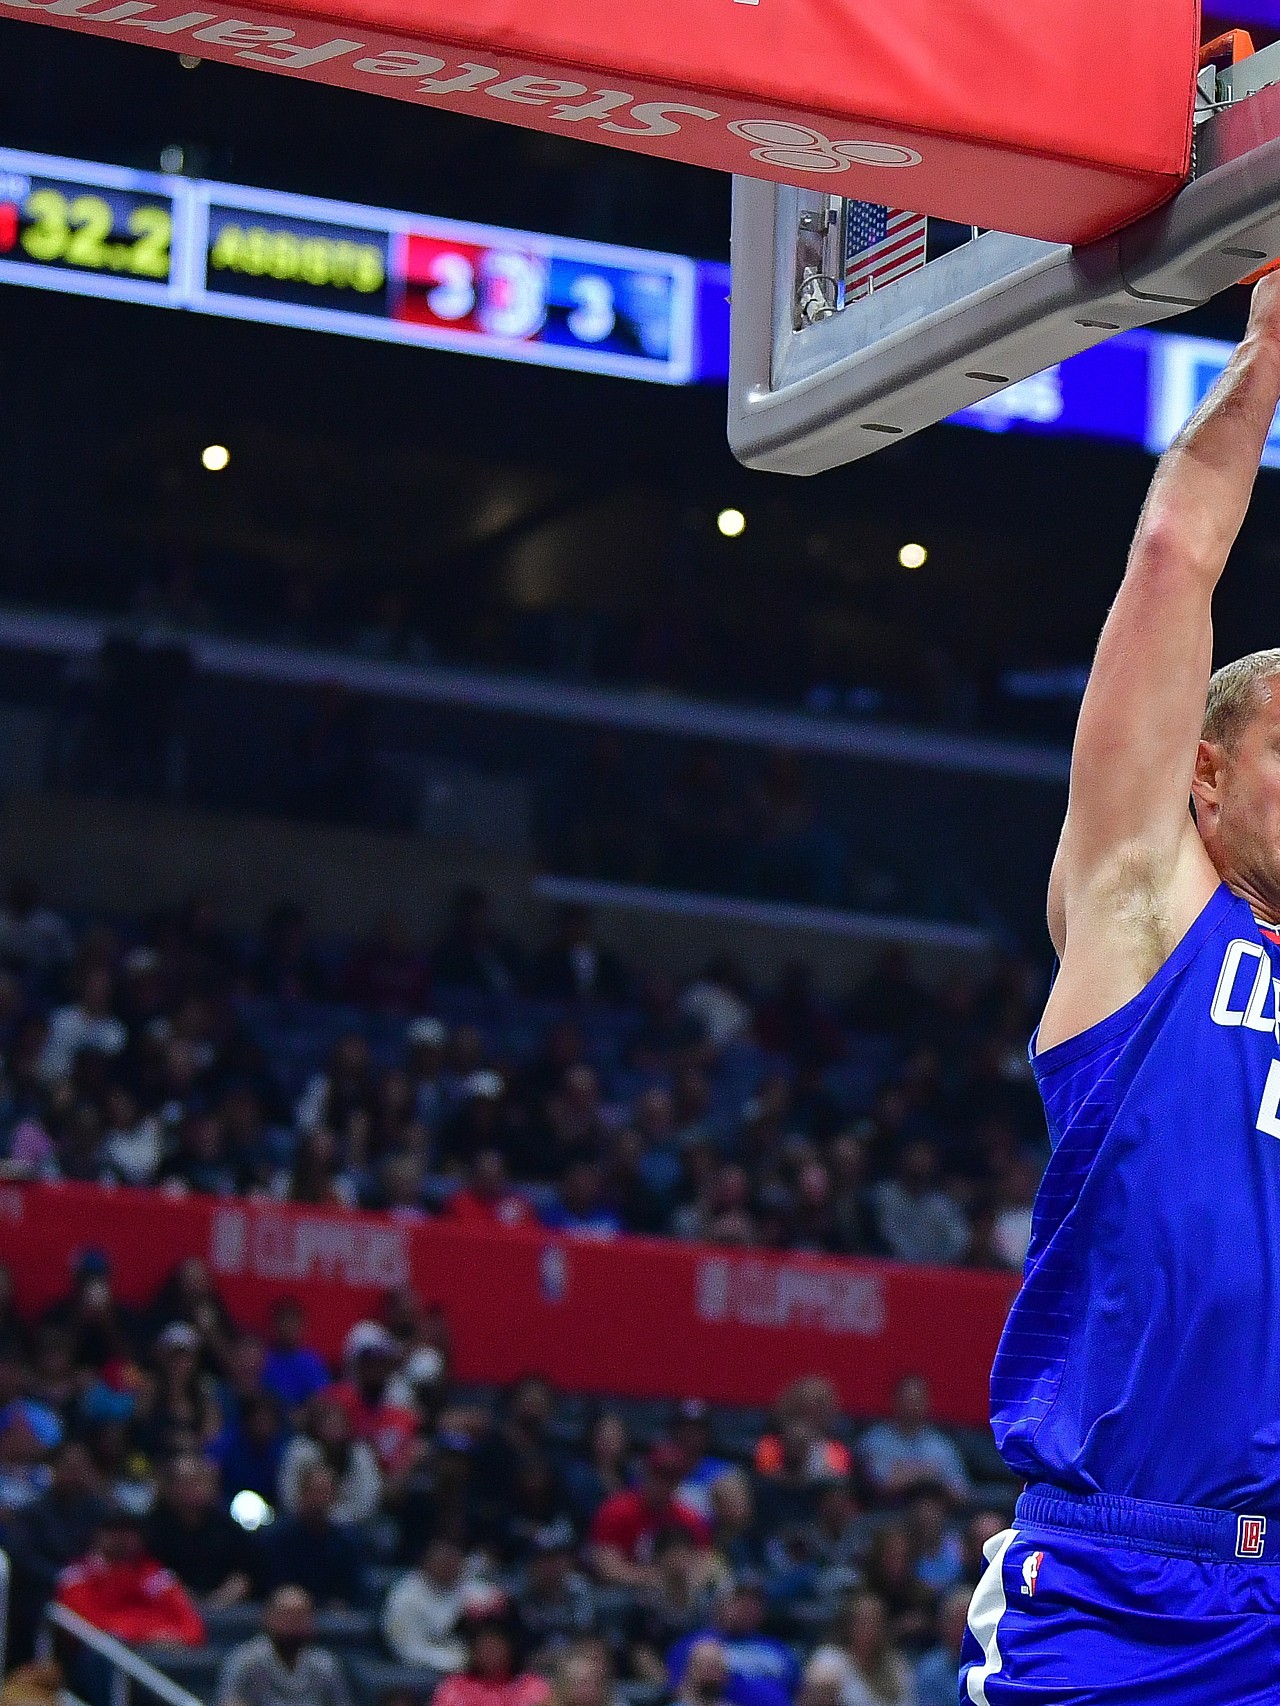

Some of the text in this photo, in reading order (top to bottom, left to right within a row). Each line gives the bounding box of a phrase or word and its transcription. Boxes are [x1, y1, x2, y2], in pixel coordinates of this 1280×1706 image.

[20, 188, 172, 278] 32.2
[427, 252, 616, 343] 3 3
